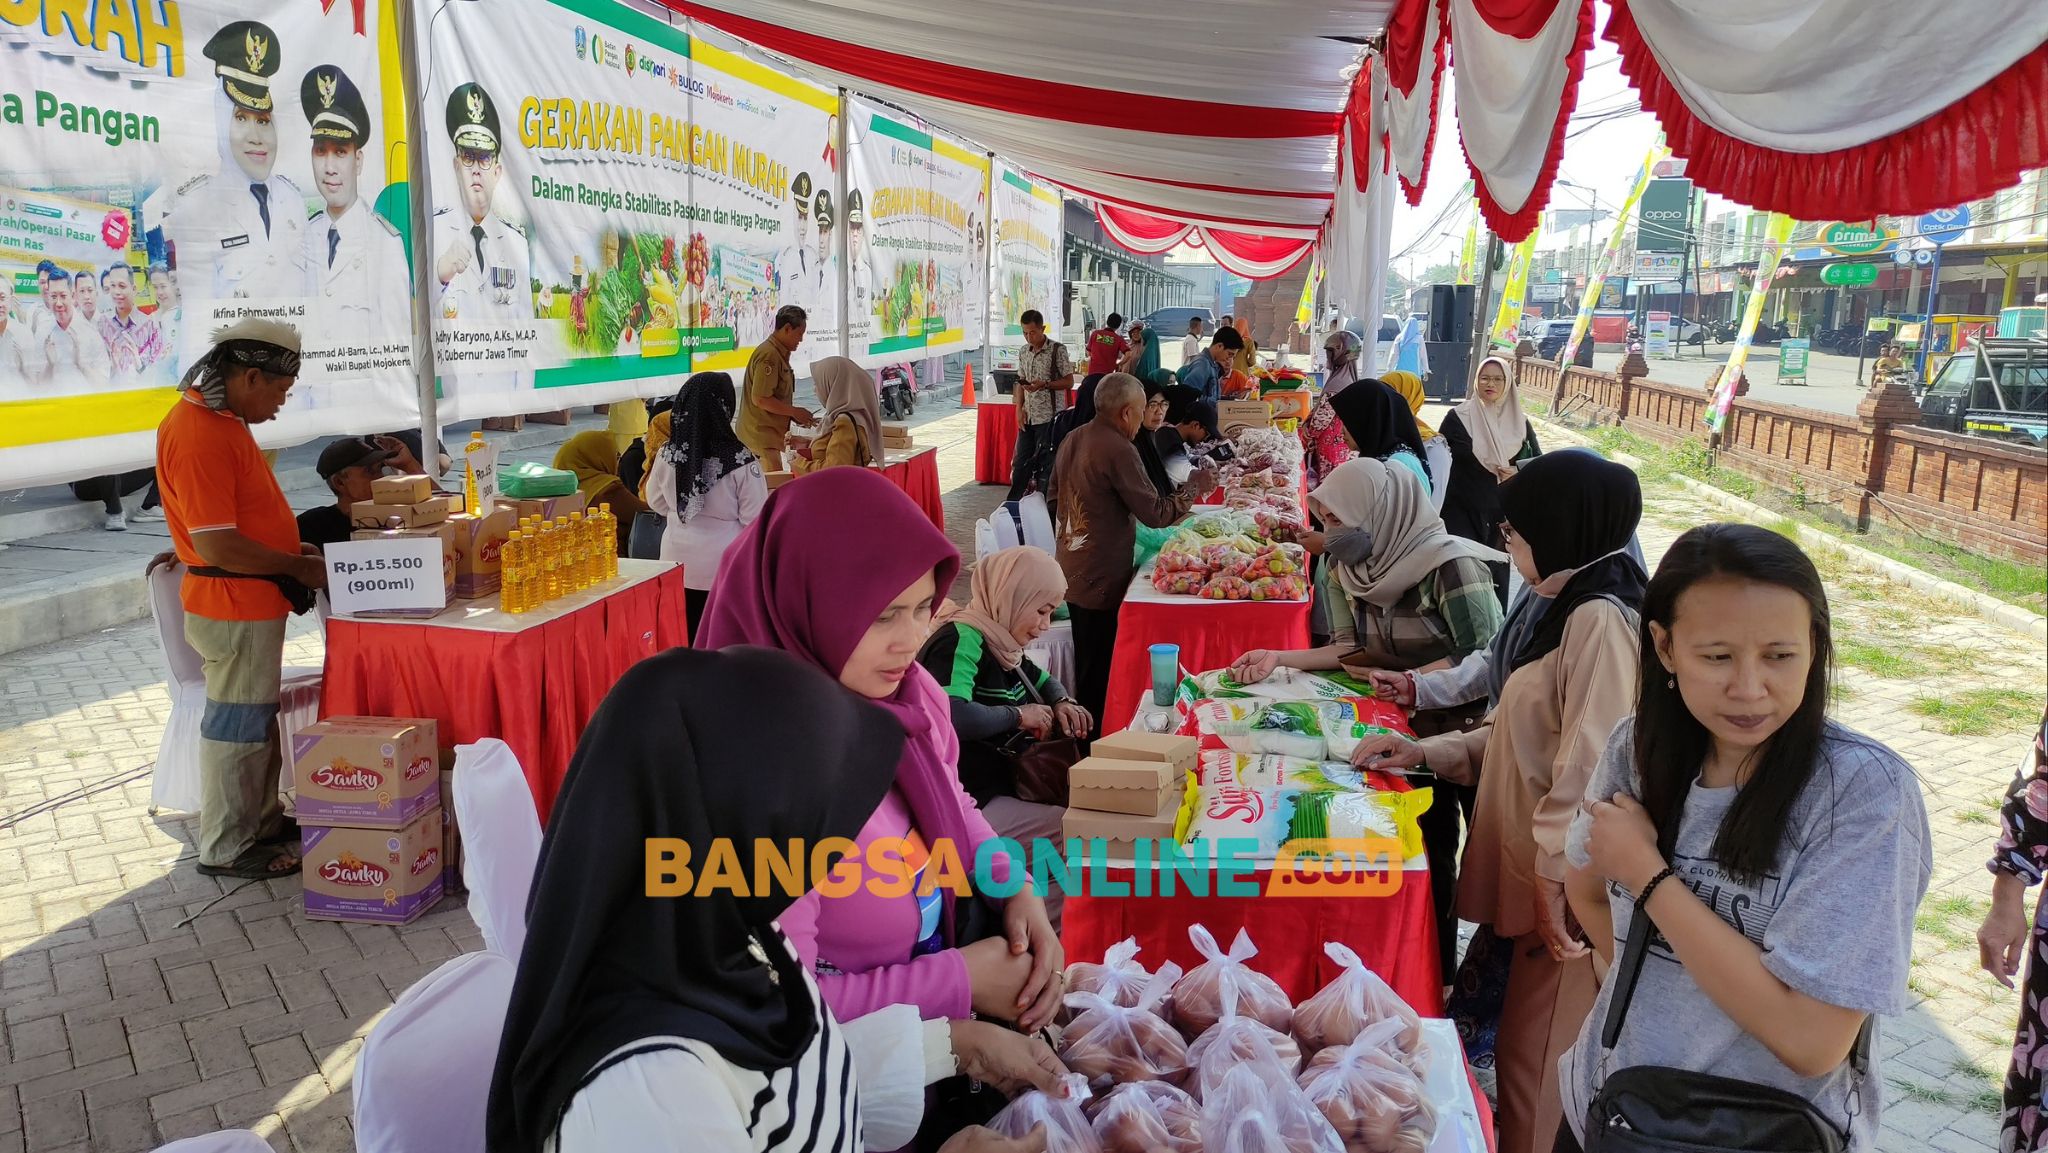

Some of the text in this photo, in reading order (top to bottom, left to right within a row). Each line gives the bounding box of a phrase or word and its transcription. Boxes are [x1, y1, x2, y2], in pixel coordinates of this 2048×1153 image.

[678, 75, 704, 95] BULOG
[0, 90, 160, 147] a Pangan
[518, 95, 788, 202] GERAKAN PANGAN MURAH
[531, 175, 781, 235] Dalam Rangka Stabilitas Pasokan dan Harga Pangan
[66, 227, 96, 243] Pasar
[1834, 231, 1878, 244] prima
[24, 237, 45, 251] Ras
[213, 305, 305, 319] Ikfina Fahmawati, M.Si
[435, 330, 452, 345] Adhy
[453, 330, 492, 344] Karyono,
[516, 329, 538, 341] M.A.P.
[300, 350, 336, 360] hammad
[337, 346, 369, 357] Al-Barra,
[383, 344, 410, 354] M.Hum
[445, 349, 484, 361] Gubernur
[485, 348, 506, 359] Jawa
[507, 347, 529, 358] Timur
[326, 358, 411, 372] Wakil Bupati Mojokerto
[333, 556, 423, 574] Rp.15.500
[347, 577, 415, 594] (900ml)
[317, 765, 378, 791] Sanky
[406, 760, 430, 780] Sanky
[412, 851, 437, 875] Sanky
[325, 860, 384, 887] Sanky
